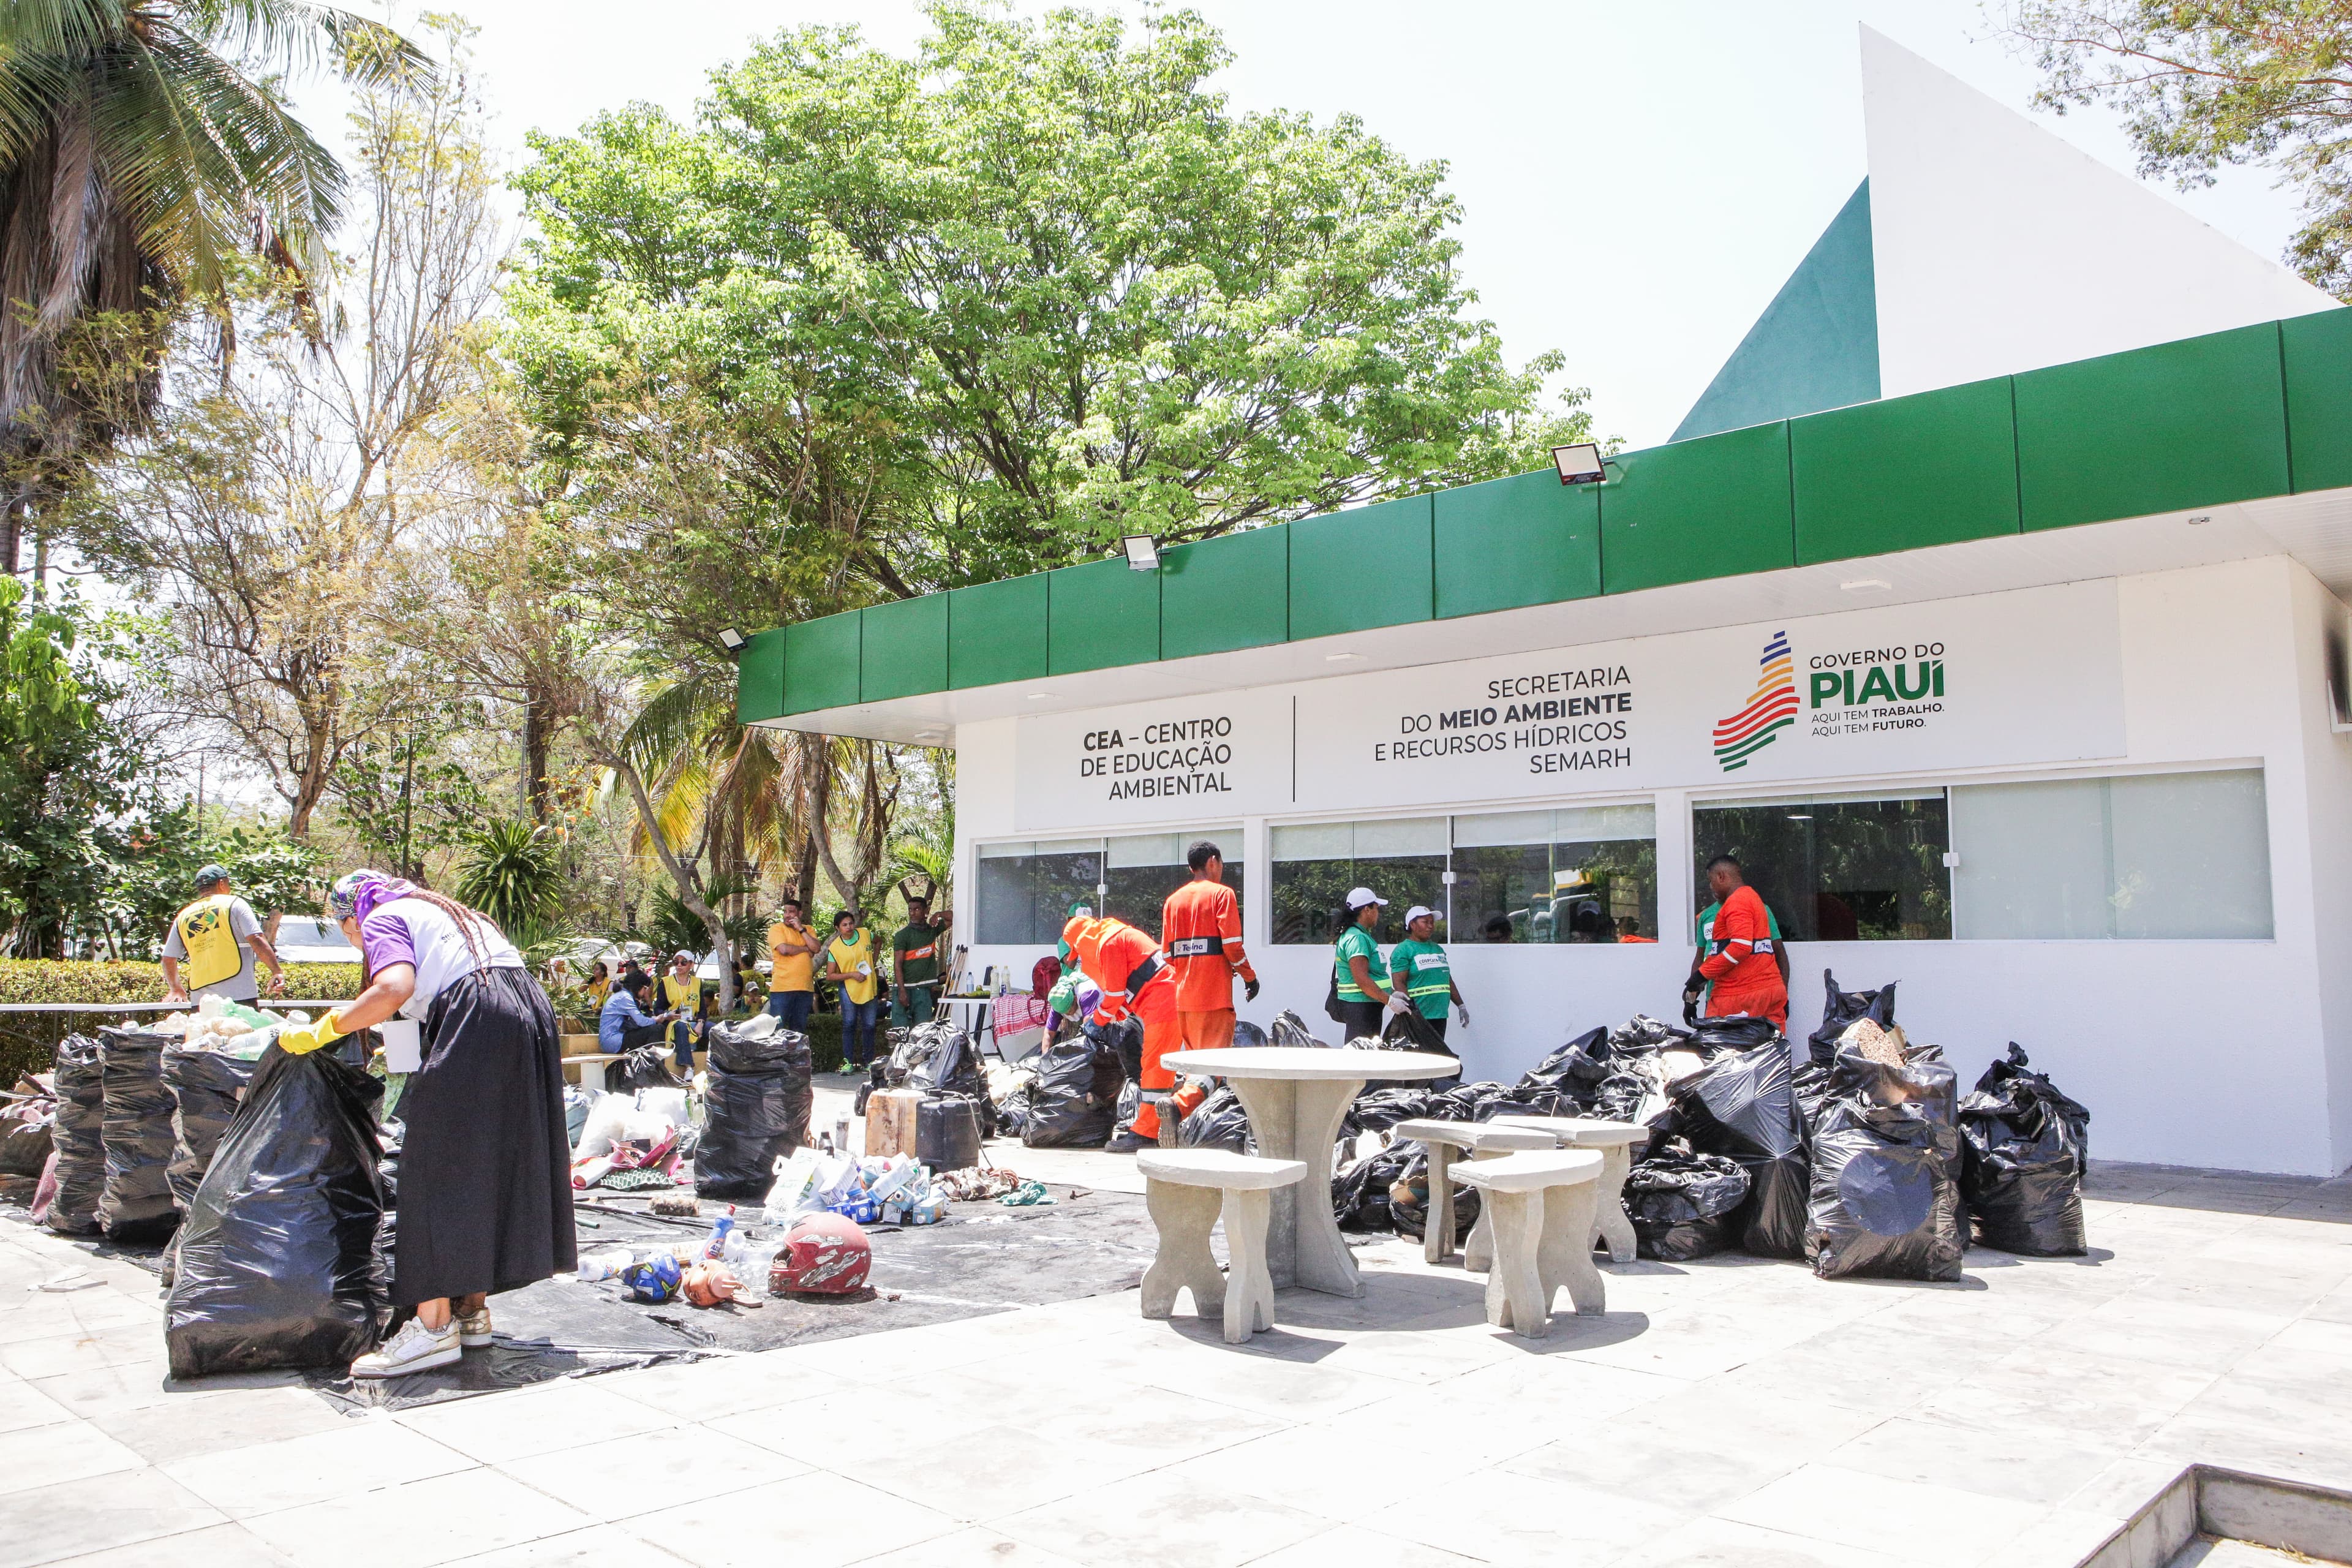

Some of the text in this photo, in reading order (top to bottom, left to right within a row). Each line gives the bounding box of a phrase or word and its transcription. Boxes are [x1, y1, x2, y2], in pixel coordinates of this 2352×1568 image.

[1810, 643, 1944, 669] GOVERNO DO
[1488, 666, 1630, 699] SECRETARIA
[1811, 660, 1944, 709] PIAUÍ
[1402, 692, 1632, 734] DO MEIO AMBIENTE
[1812, 703, 1944, 723] AQUI TEM TRABALHO.
[1812, 718, 1926, 737] AQUI TEM FUTURO.
[1084, 729, 1123, 751] CEA
[1145, 717, 1231, 744] CENTRO
[1376, 720, 1626, 761] E RECURSOS HÍDRICOS
[1082, 741, 1231, 777] DE EDUCAÇÃO
[1530, 747, 1630, 774] SEMARH
[1109, 772, 1231, 800] AMBIENTAL
